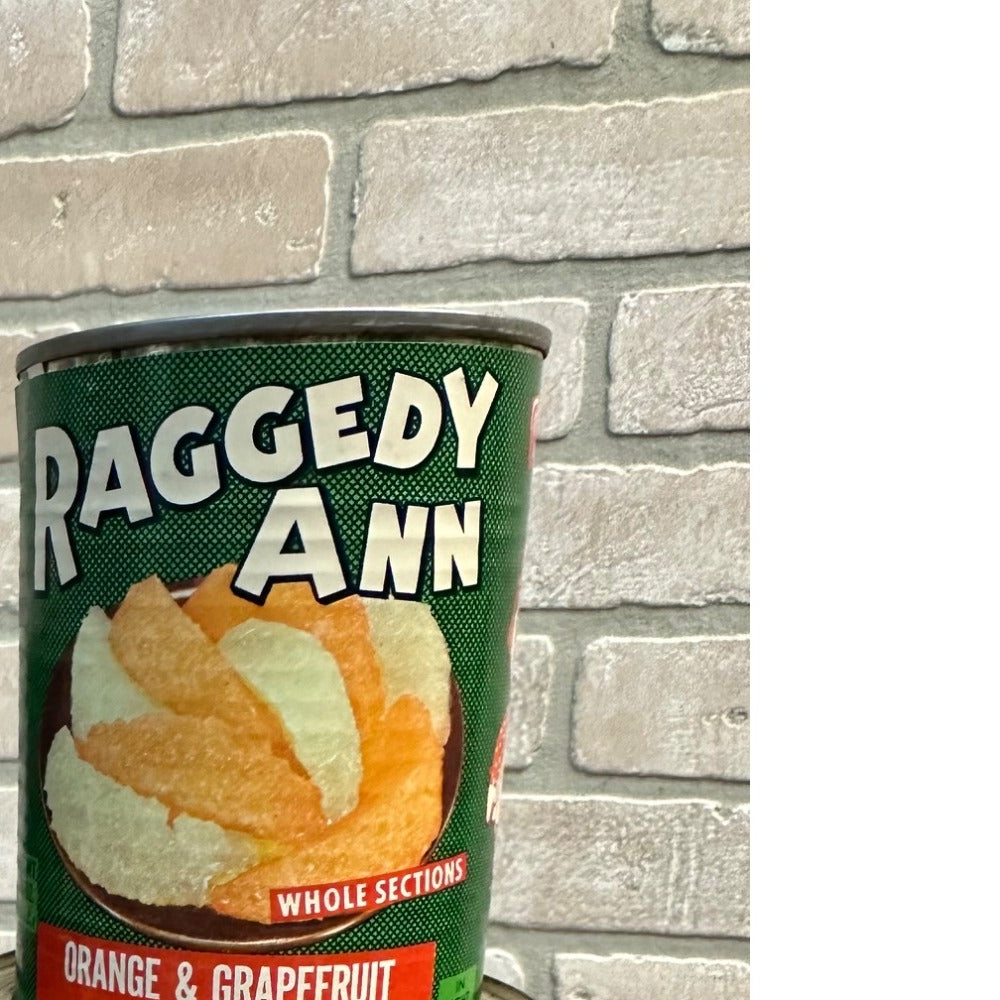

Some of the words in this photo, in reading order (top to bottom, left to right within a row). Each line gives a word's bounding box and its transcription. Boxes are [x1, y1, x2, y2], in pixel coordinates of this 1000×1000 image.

[34, 367, 499, 591] RAGGEDY
[233, 486, 482, 599] ANN
[277, 884, 368, 918] WHOLE
[375, 858, 464, 905] SECTIONS
[63, 941, 161, 1000] ORANGE
